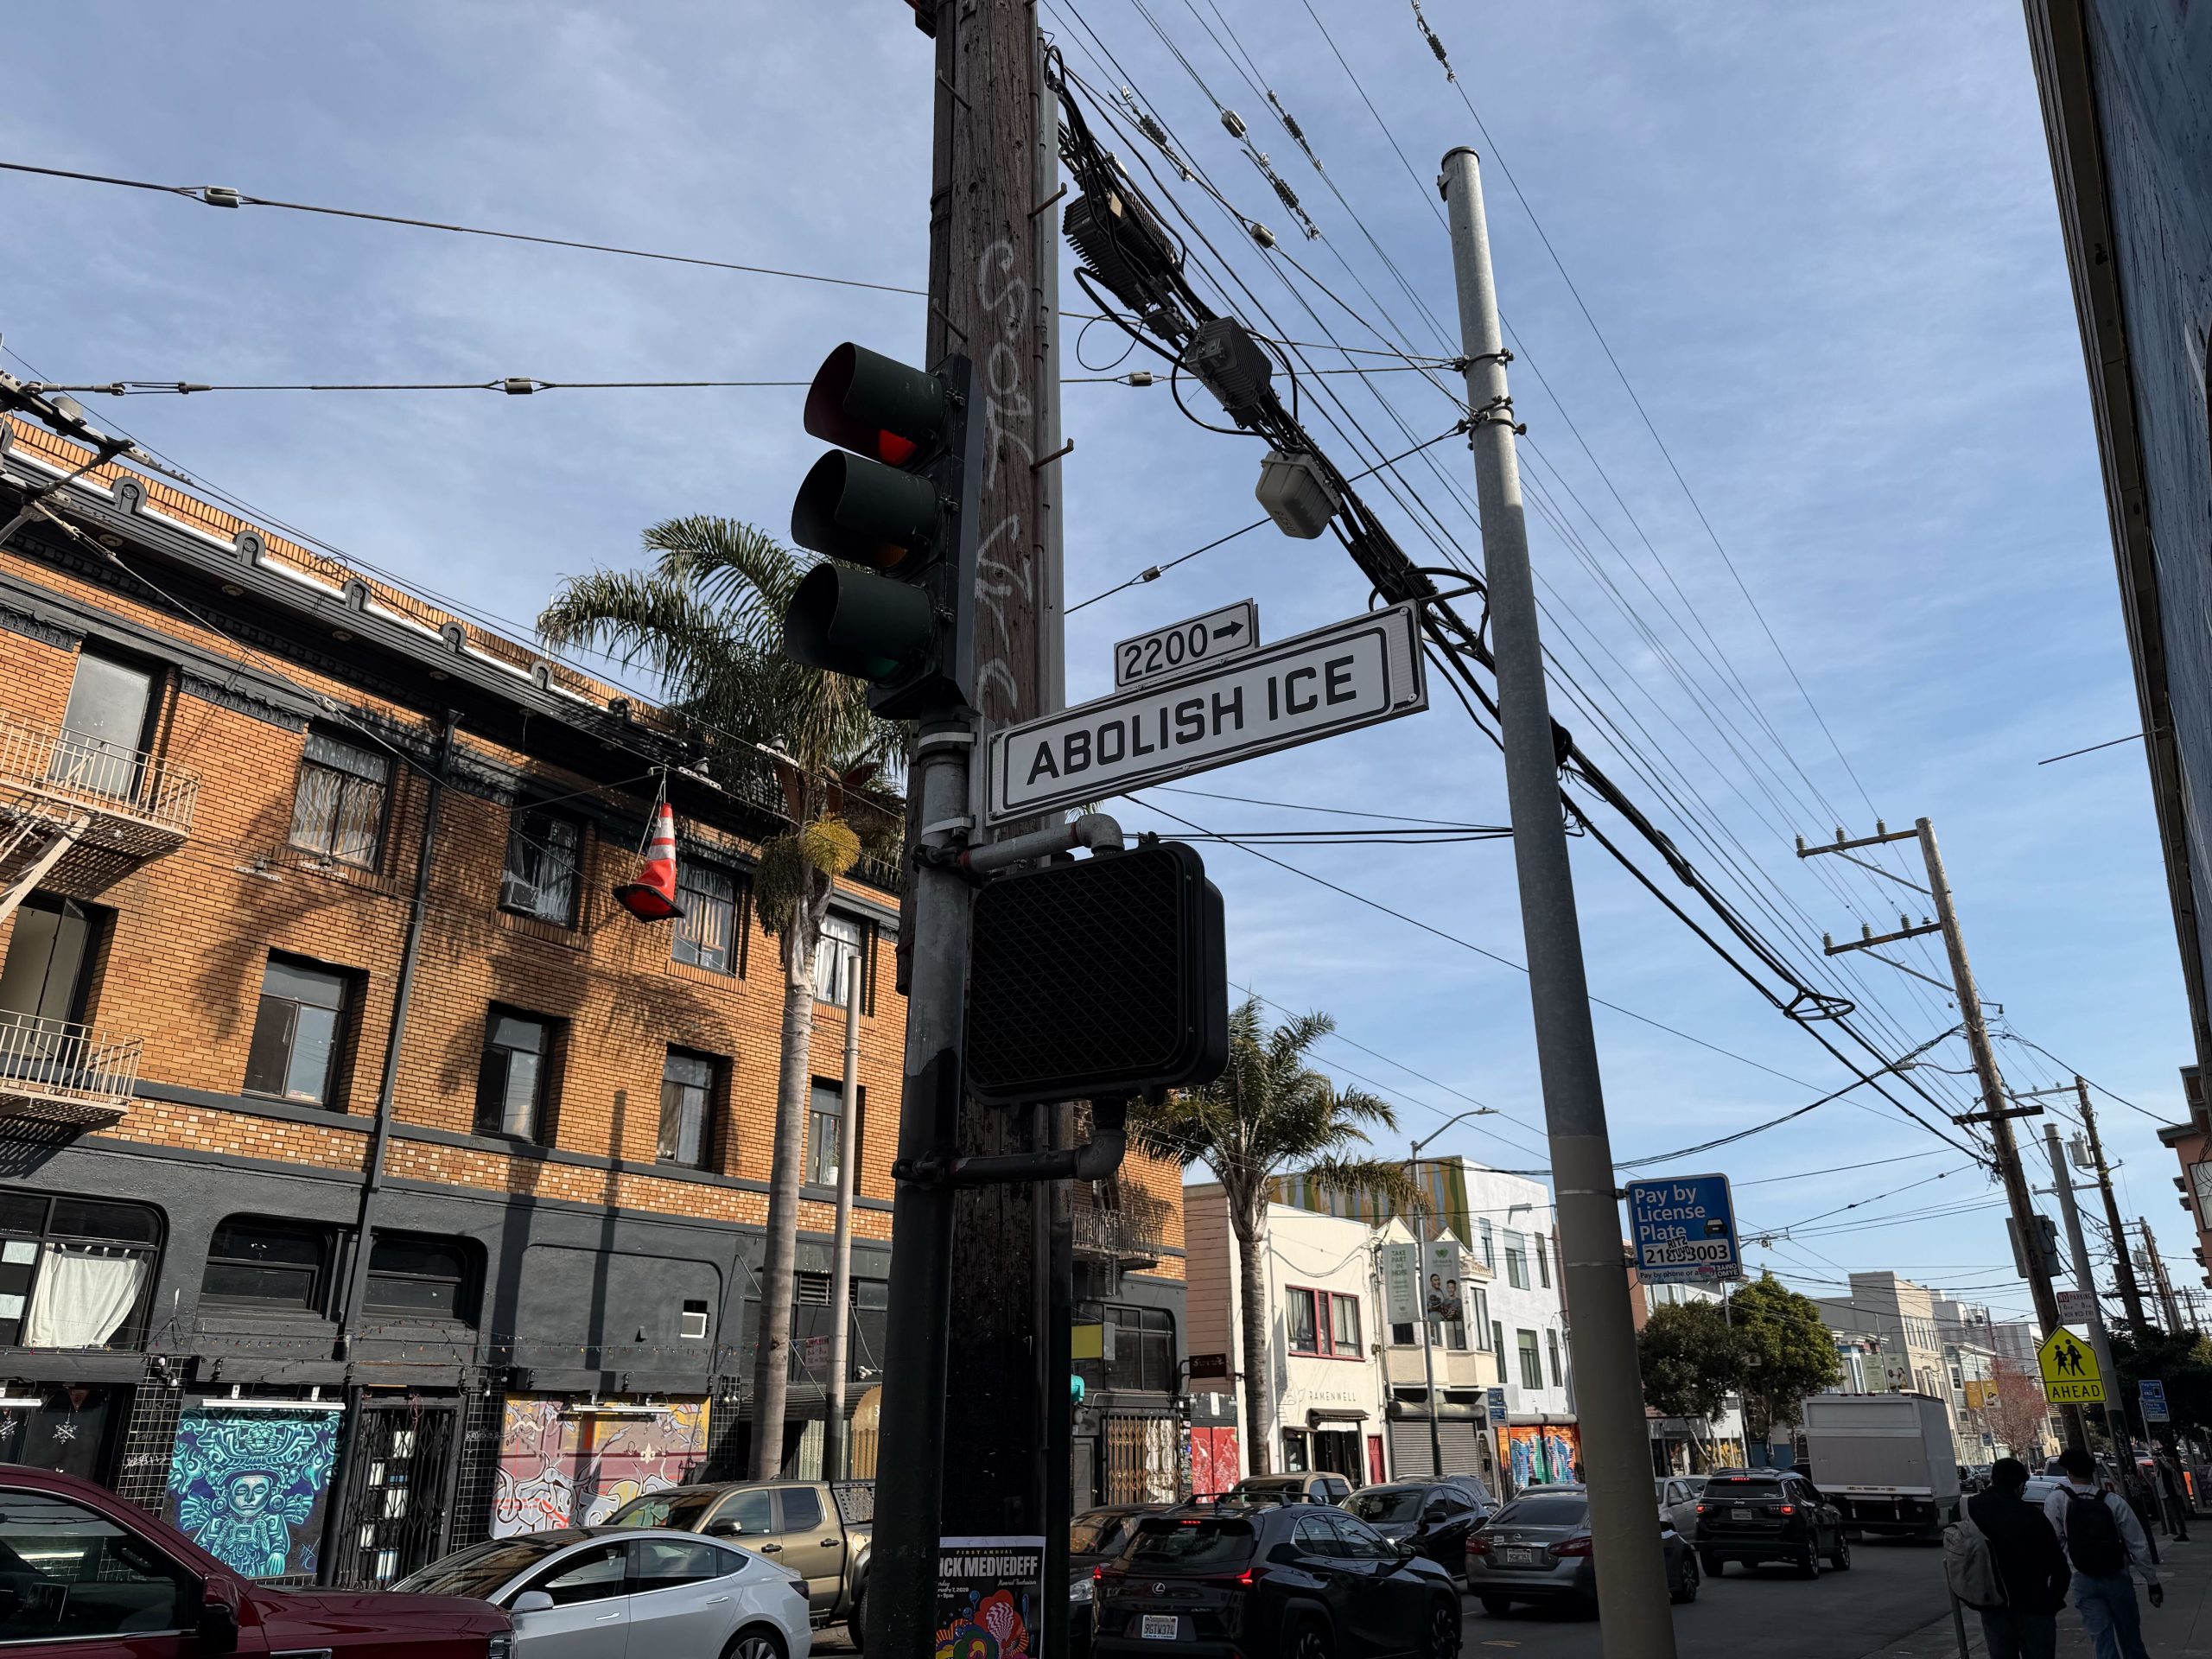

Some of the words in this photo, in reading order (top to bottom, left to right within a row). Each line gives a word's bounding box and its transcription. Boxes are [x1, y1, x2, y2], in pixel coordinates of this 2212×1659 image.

[1123, 623, 1208, 680] 2200
[1027, 686, 1243, 785] ABOLISH
[1268, 654, 1357, 721] ICE
[1634, 1188, 1668, 1206] Pay
[1673, 1184, 1697, 1204] by
[1637, 1206, 1706, 1223] License
[1639, 1224, 1687, 1242] Plate
[1666, 1236, 1688, 1249] RITZ
[1654, 1270, 1662, 1279] by
[1663, 1268, 1684, 1278] phone
[2058, 1293, 2069, 1301] NO
[1309, 1389, 1357, 1402] RAMENWELL
[2052, 1384, 2101, 1399] AHEAD
[964, 1556, 1039, 1577] MEDVEDEFF
